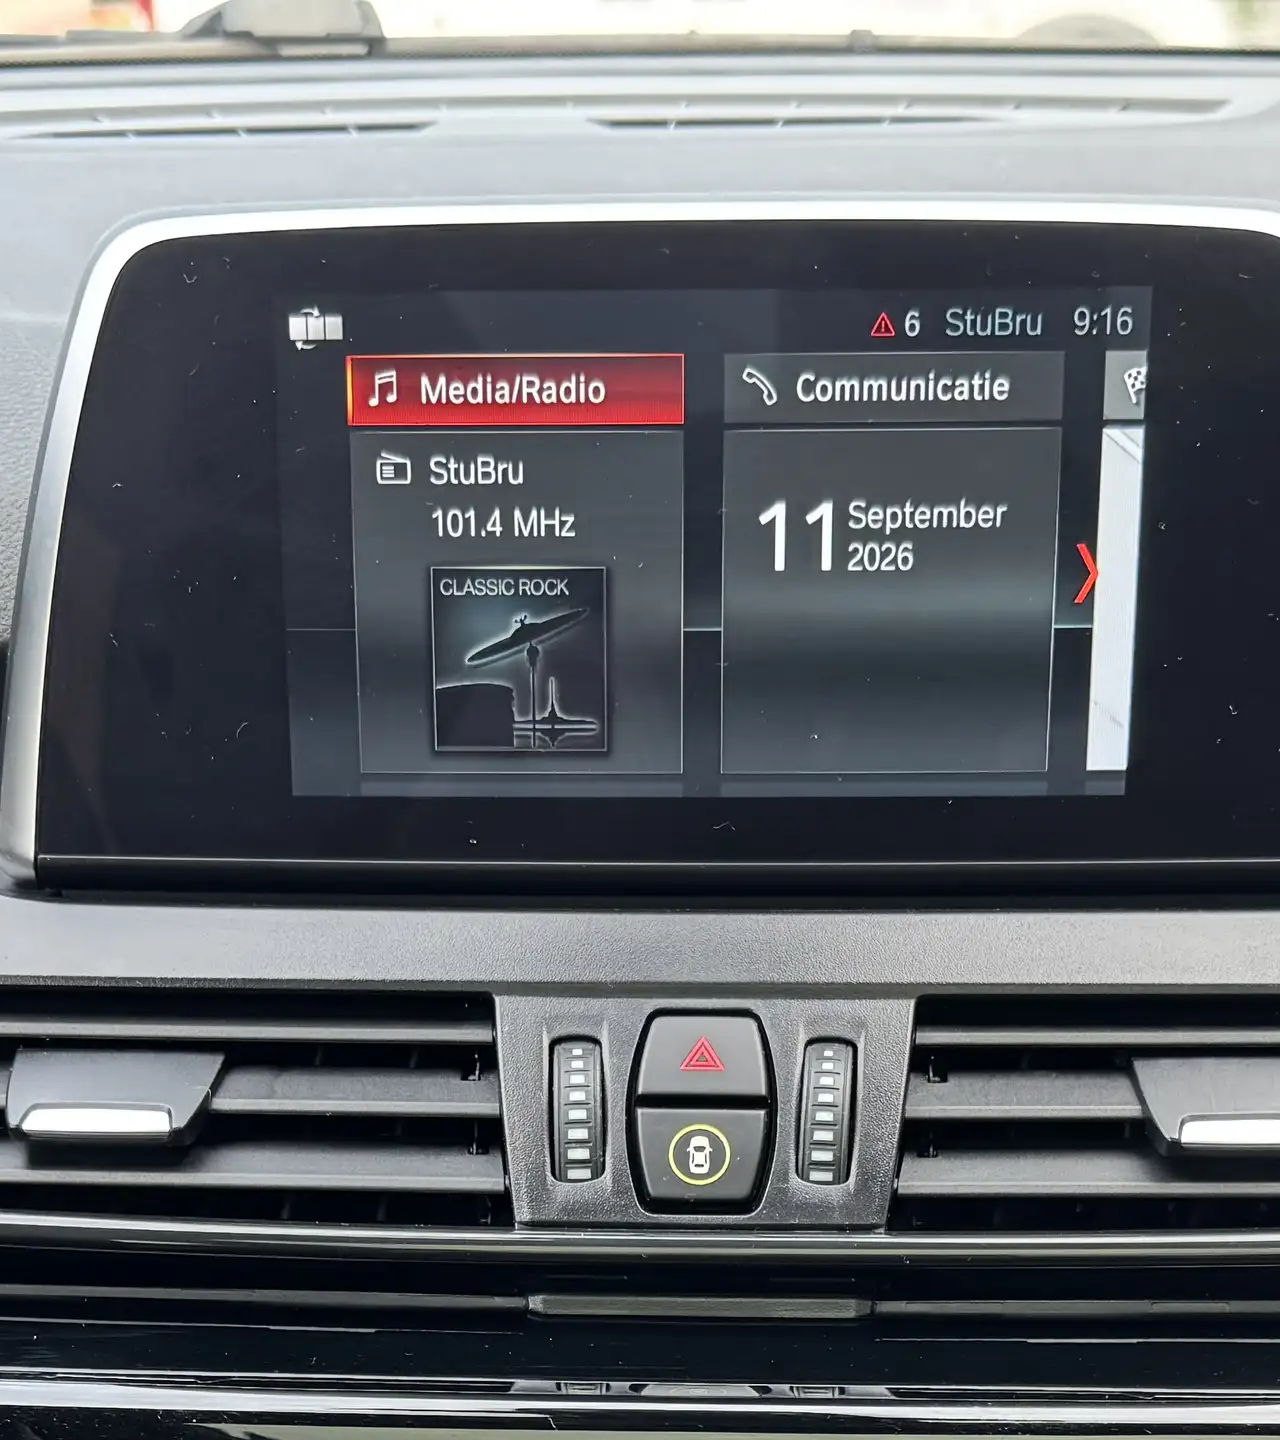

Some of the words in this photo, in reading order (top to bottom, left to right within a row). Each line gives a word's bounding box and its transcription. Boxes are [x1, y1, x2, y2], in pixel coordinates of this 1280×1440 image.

[904, 311, 920, 337] 6
[945, 308, 1042, 337] StuBru
[1074, 306, 1133, 335] 9:16
[420, 373, 606, 405] Media/Radio
[796, 370, 1010, 403] Communicatie
[429, 454, 524, 485] StuBru
[431, 507, 504, 538] 101.4
[513, 508, 576, 538] MHz
[758, 500, 834, 571] 11
[847, 498, 1008, 535] September
[847, 542, 914, 572] 2026
[439, 579, 515, 596] CLASSIC
[519, 579, 570, 596] ROCK
